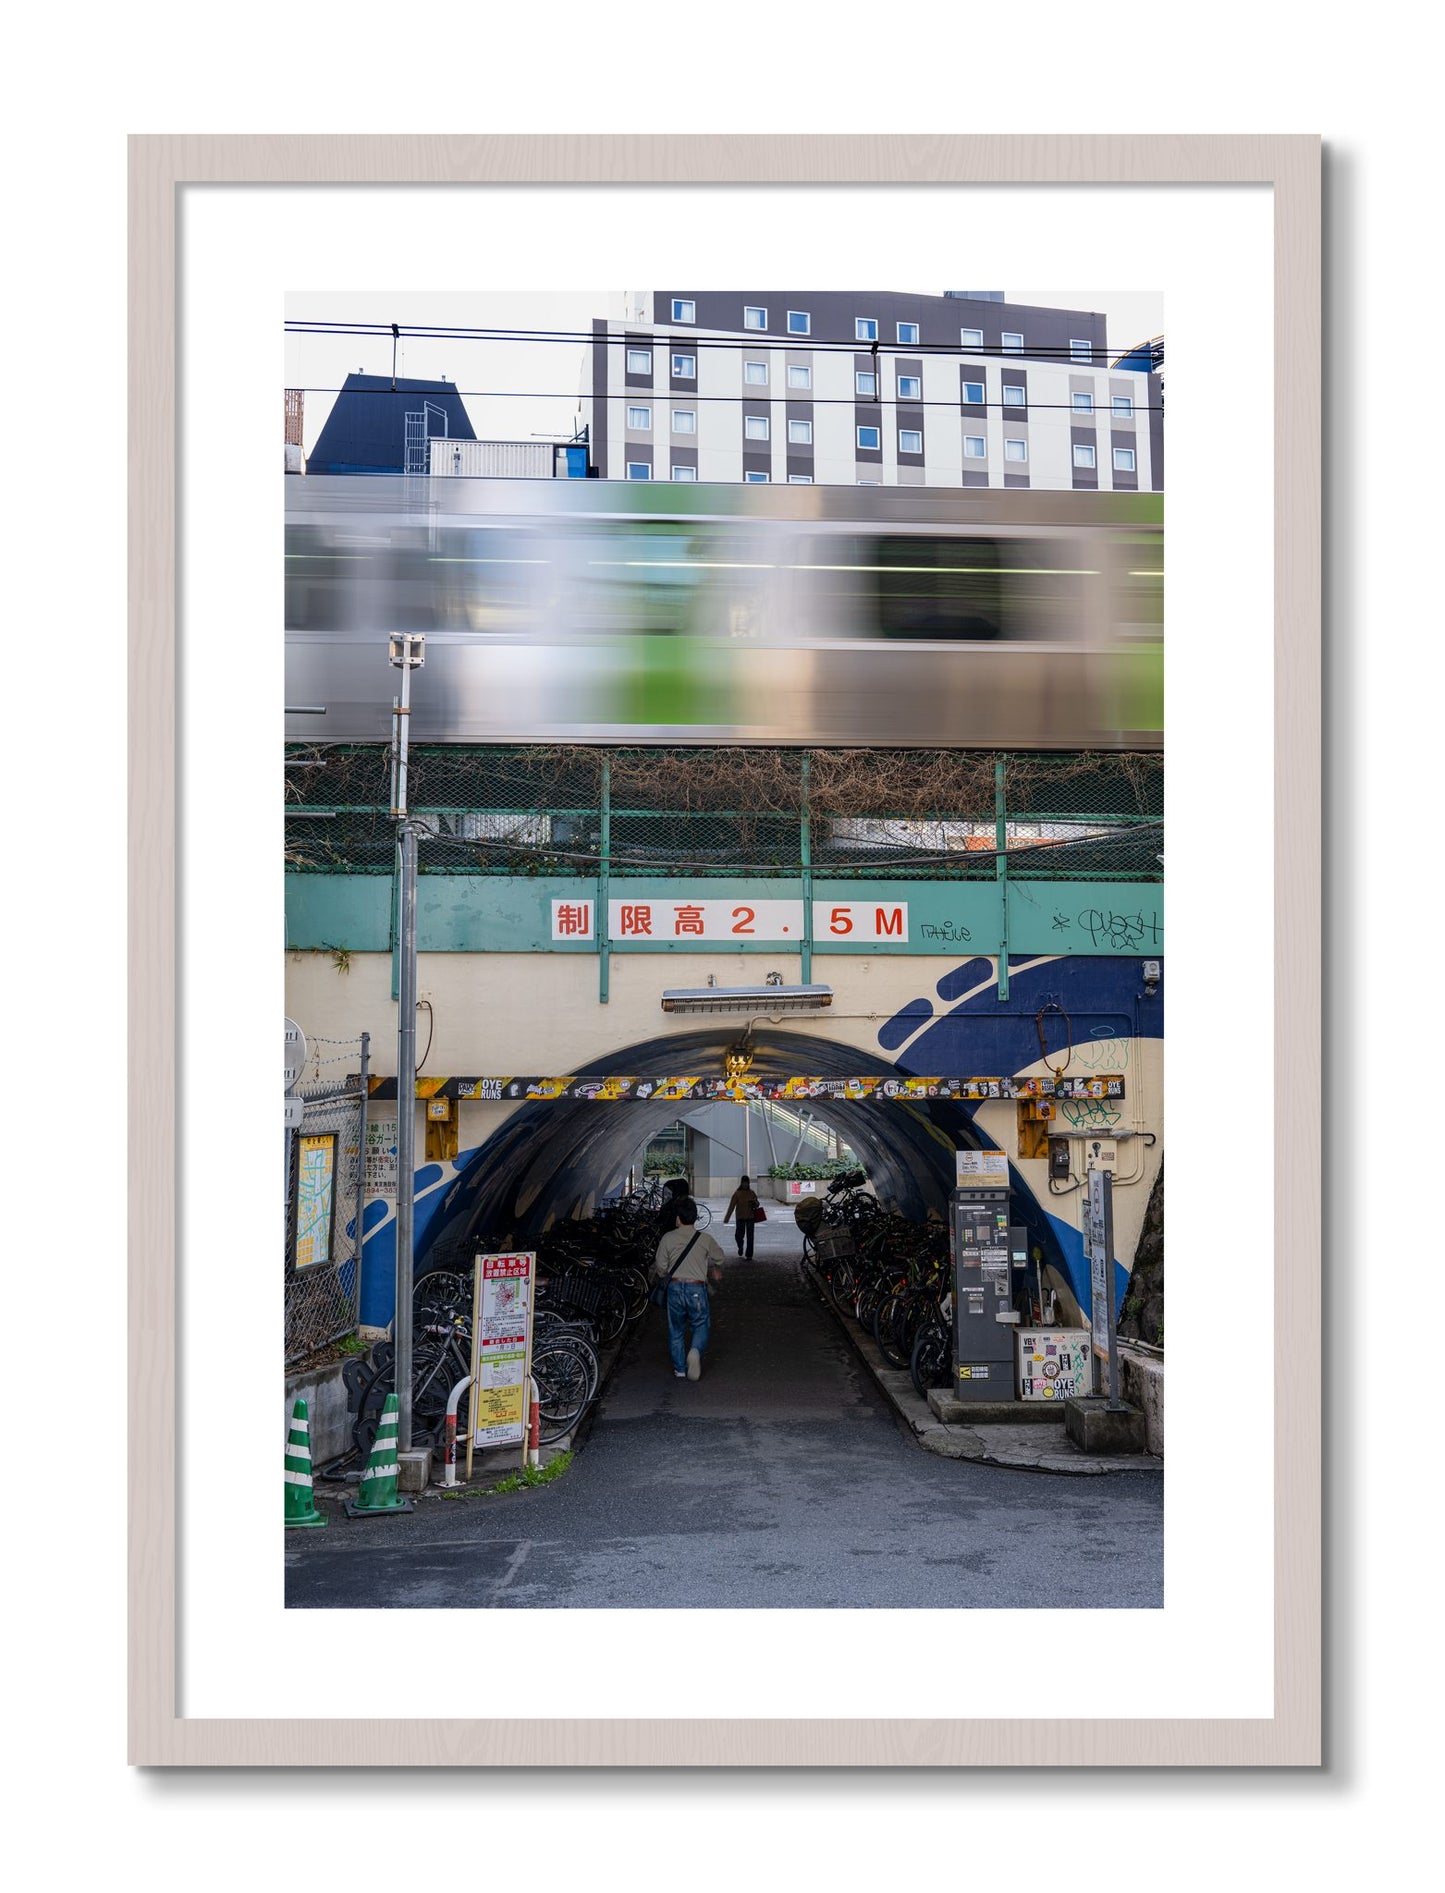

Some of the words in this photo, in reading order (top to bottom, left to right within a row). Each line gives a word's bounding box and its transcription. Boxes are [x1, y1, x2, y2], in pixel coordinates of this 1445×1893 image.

[482, 1079, 502, 1090] OYE
[481, 1089, 502, 1100] RUNS
[1054, 1379, 1075, 1389] OYE
[1054, 1388, 1075, 1400] RUNS
